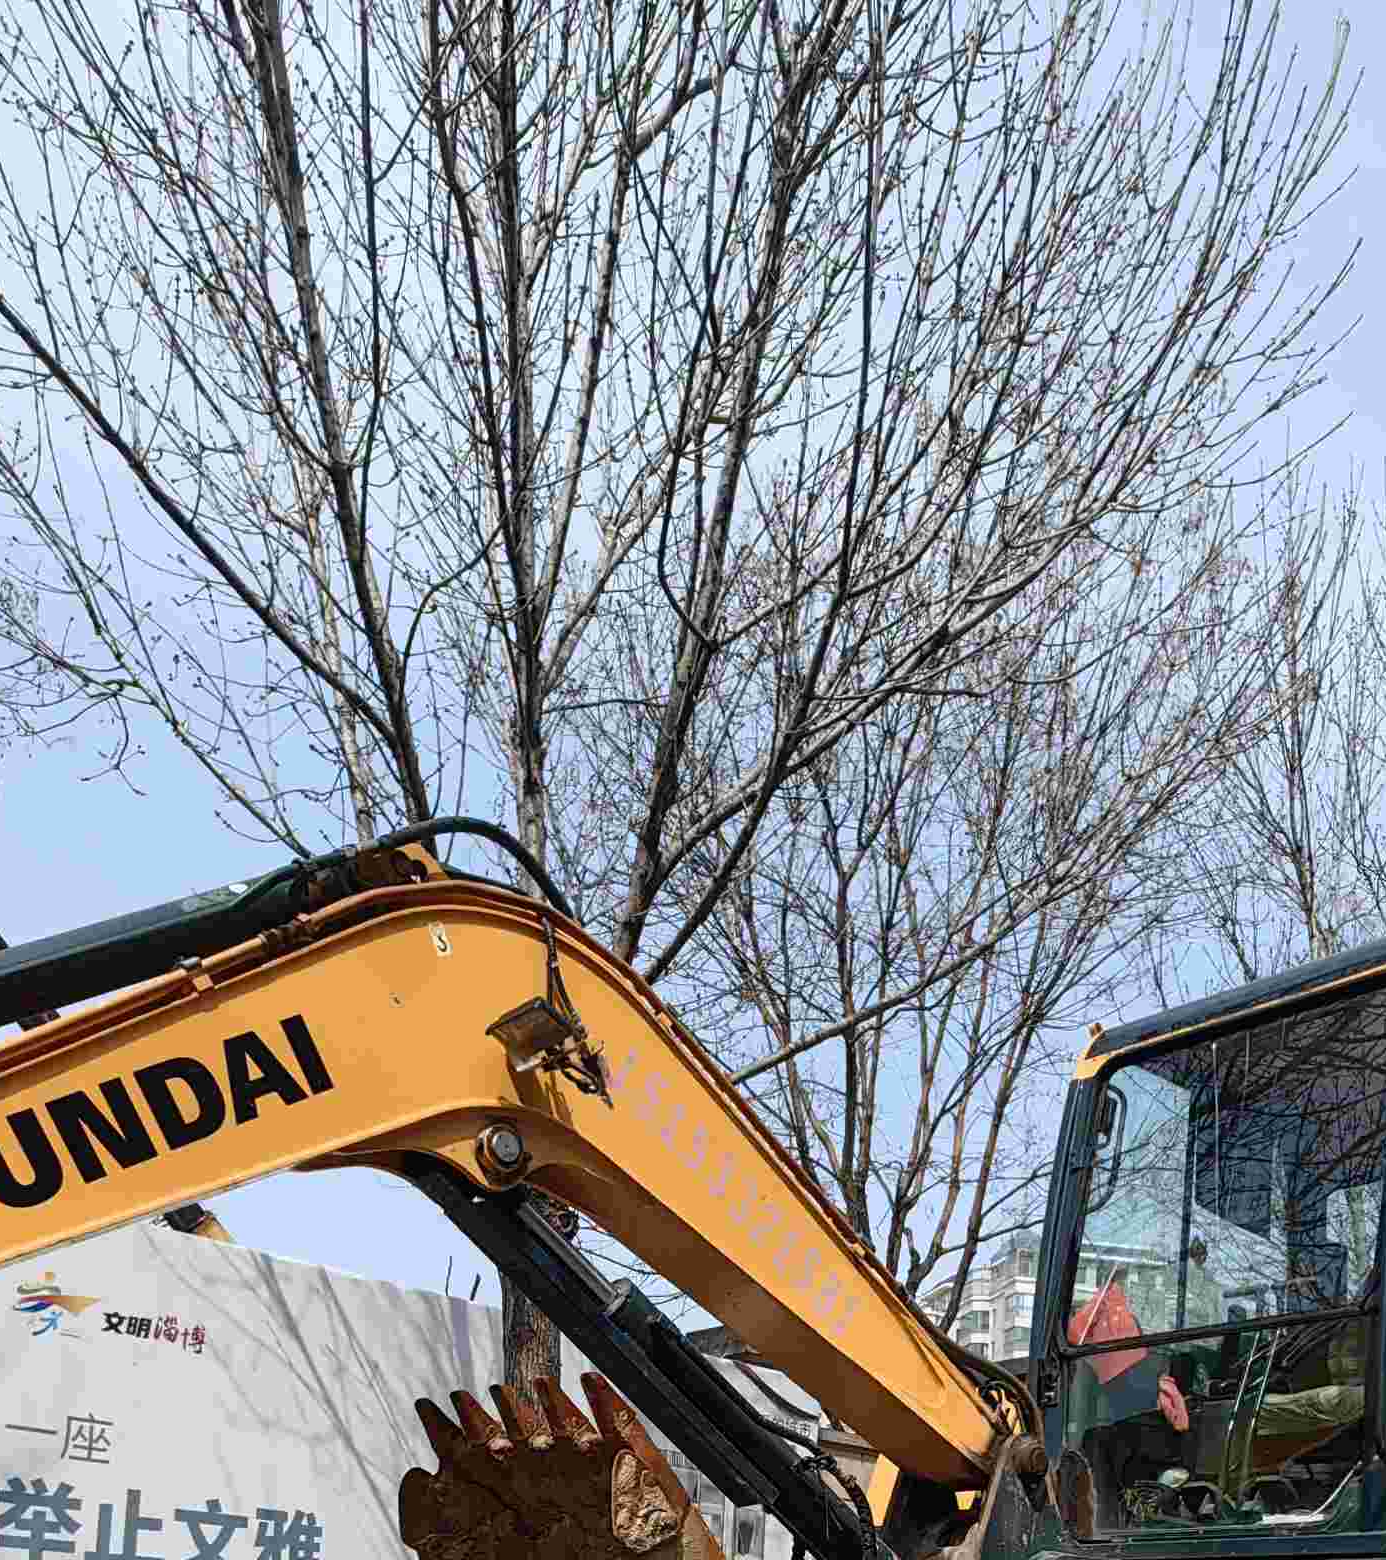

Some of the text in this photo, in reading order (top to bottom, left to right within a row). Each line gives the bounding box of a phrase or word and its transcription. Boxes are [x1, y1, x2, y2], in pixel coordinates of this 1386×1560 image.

[101, 1312, 205, 1354] 文明淄博
[4, 1412, 114, 1464] 一座
